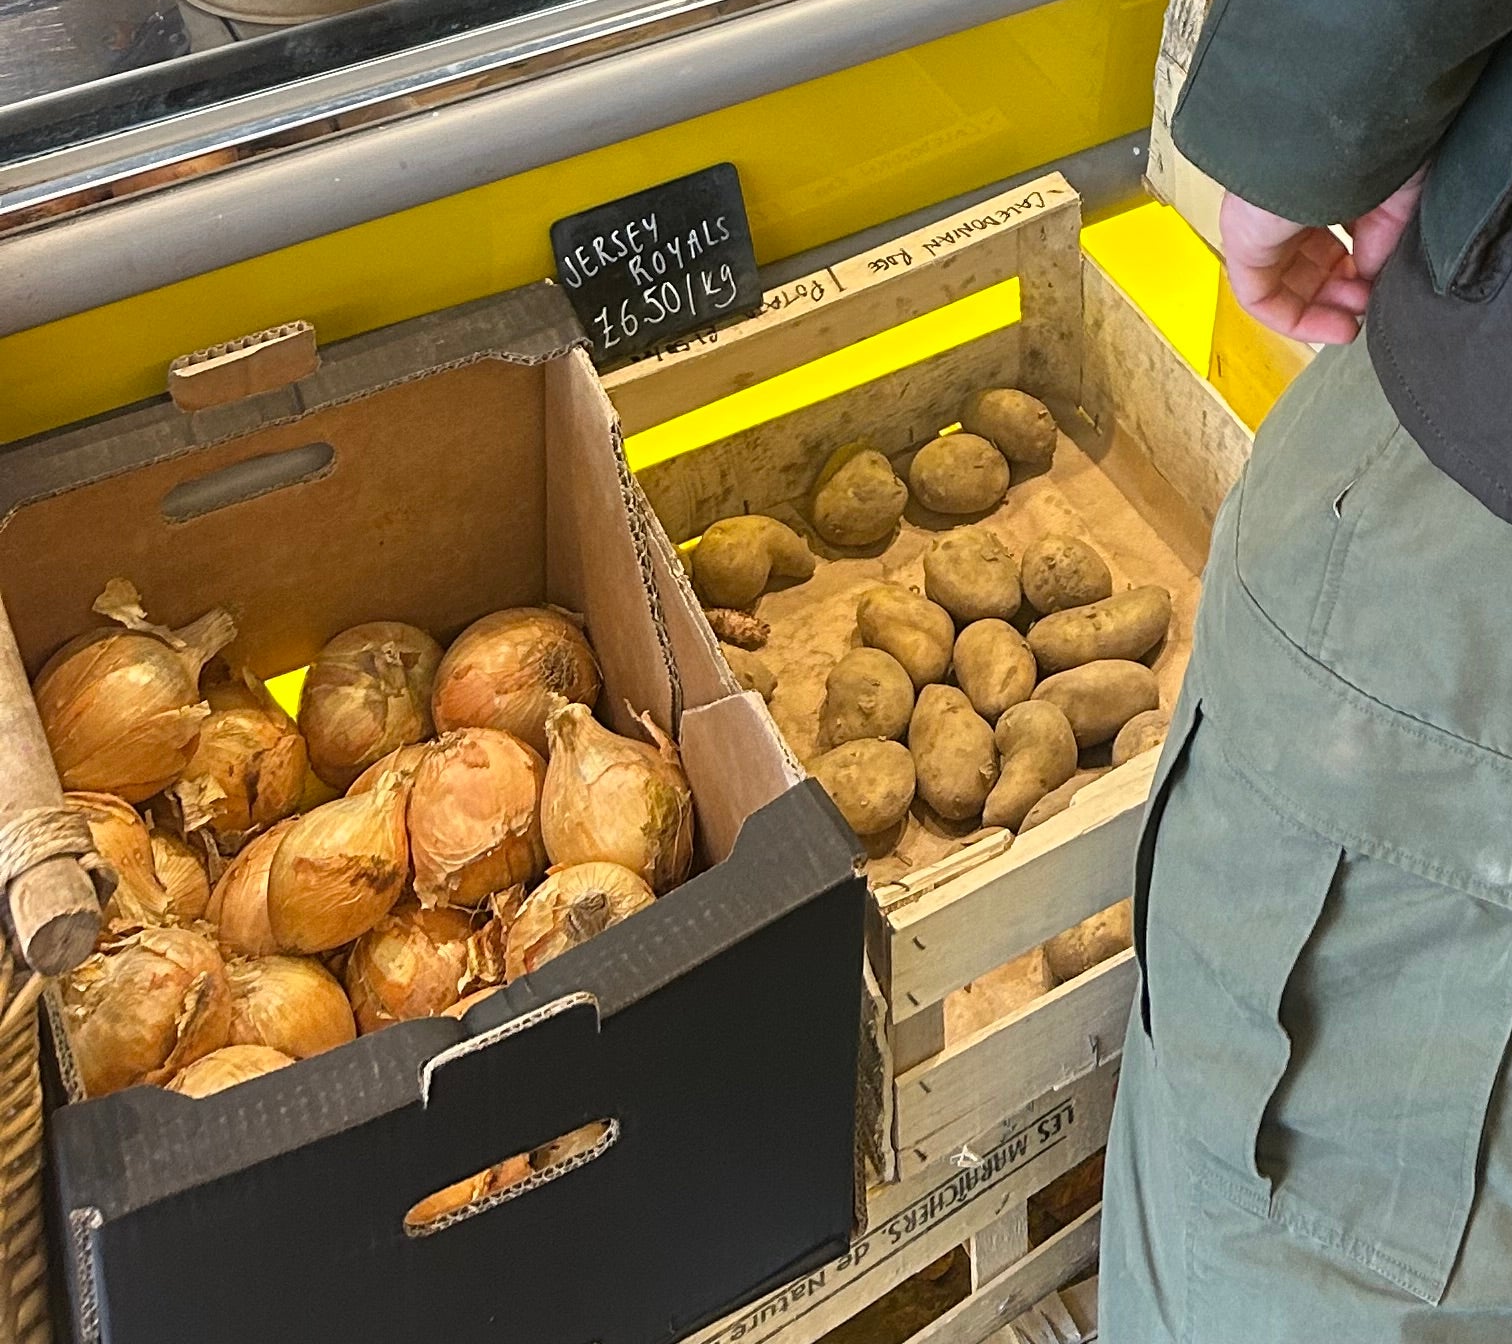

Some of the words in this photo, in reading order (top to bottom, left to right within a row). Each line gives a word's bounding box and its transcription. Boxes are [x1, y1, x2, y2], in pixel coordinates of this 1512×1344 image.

[564, 212, 659, 290] JERSEY
[629, 214, 731, 287] ROYALS
[921, 190, 1047, 255] CALEDONIAN
[1037, 1106, 1075, 1143] LES
[836, 1243, 871, 1272] de
[730, 1268, 826, 1338] Nature
